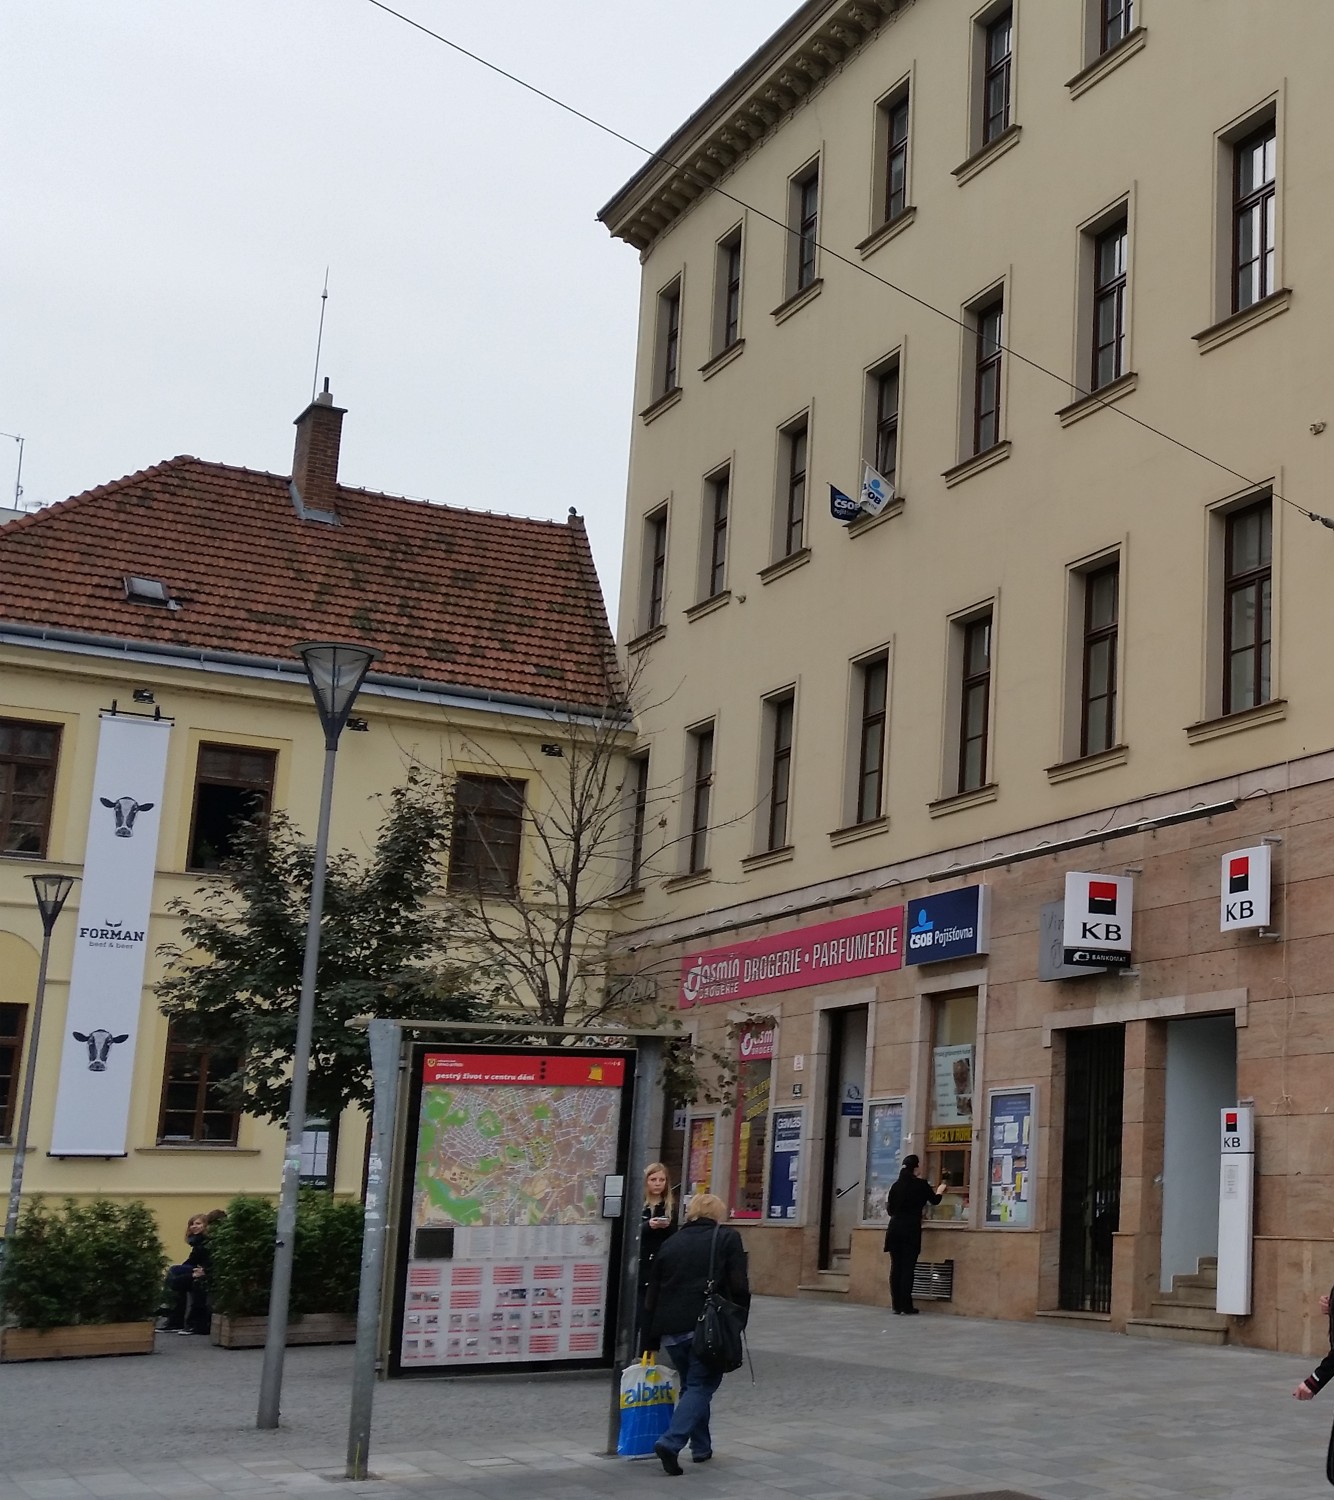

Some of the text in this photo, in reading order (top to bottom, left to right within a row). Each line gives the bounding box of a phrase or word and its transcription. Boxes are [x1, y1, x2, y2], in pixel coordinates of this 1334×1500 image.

[1226, 900, 1254, 922] KB
[80, 927, 145, 941] FORMAN
[909, 925, 974, 949] ČSOB Pojišťovna
[1081, 922, 1122, 941] KB
[743, 927, 899, 983] DROGERIE PARFUMERIE
[1091, 954, 1127, 963] BANKOMAT
[435, 1072, 462, 1081] pestrý
[462, 1072, 482, 1080] život
[1223, 1137, 1241, 1148] KB
[624, 1381, 673, 1405] albert
